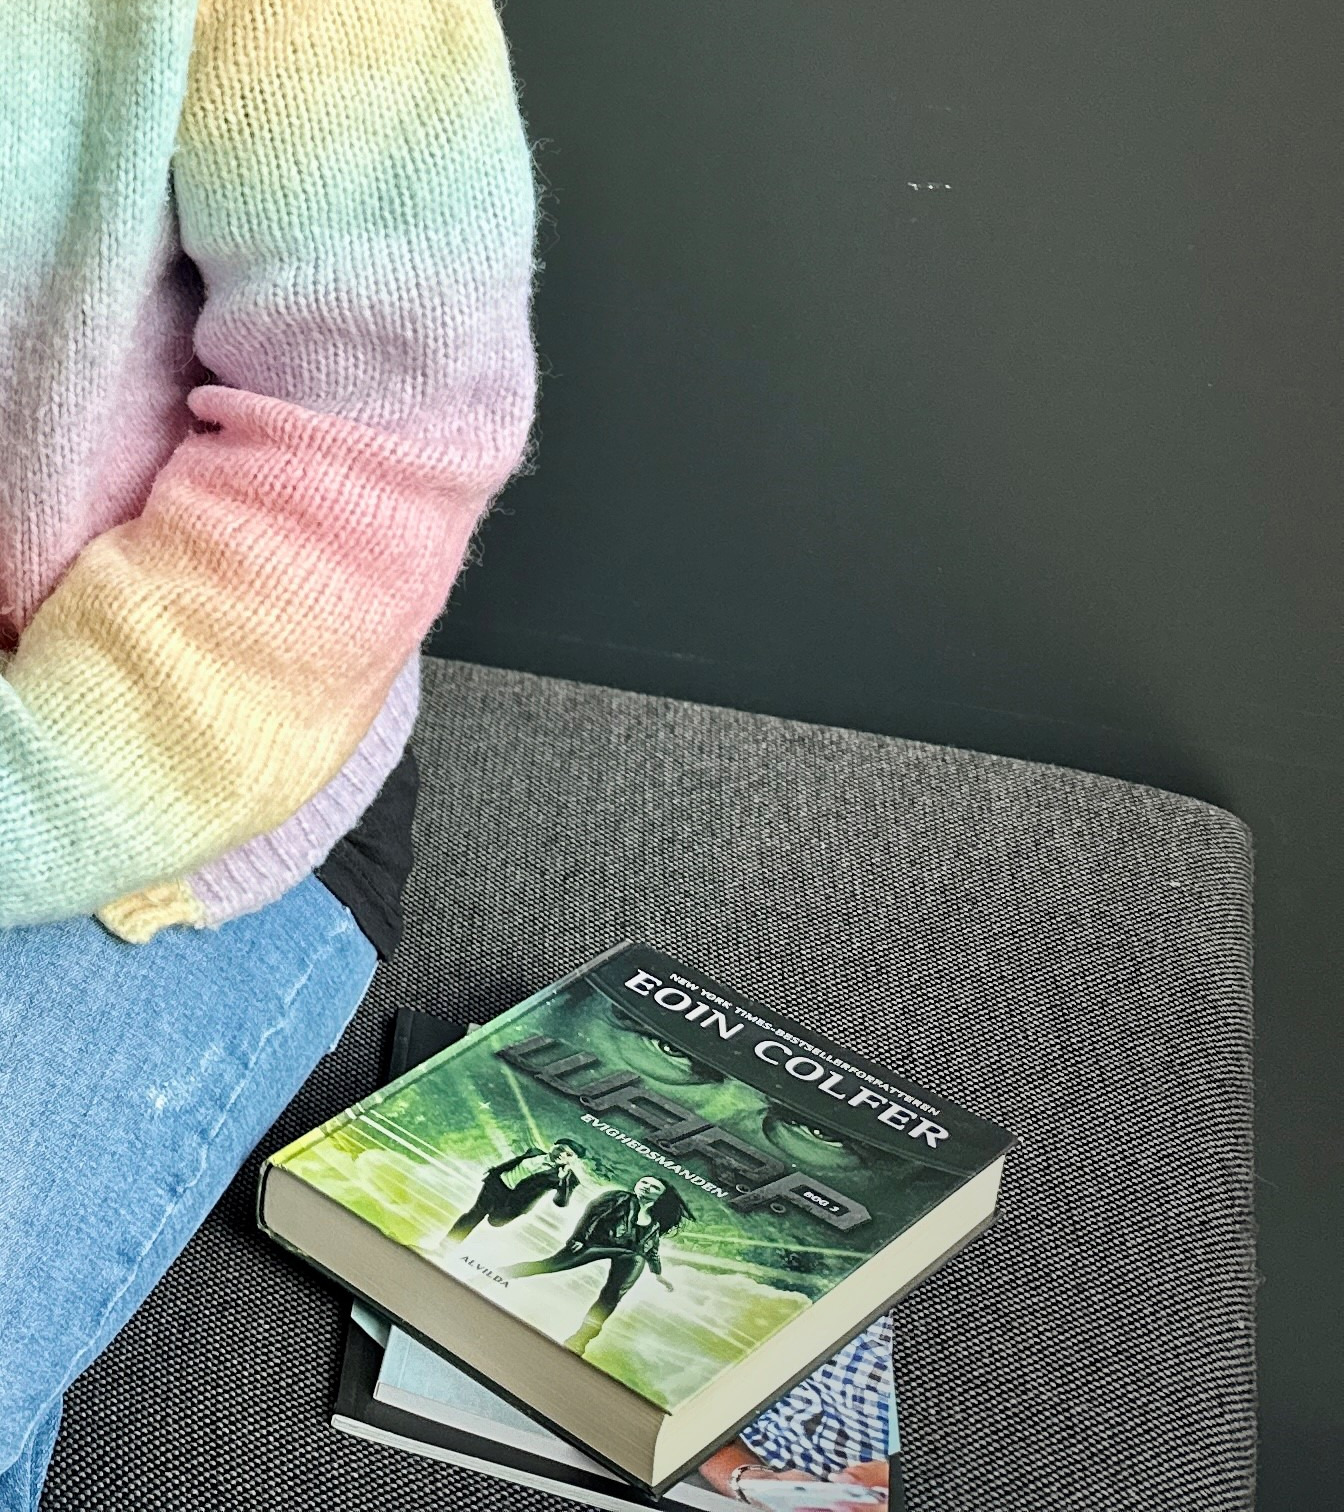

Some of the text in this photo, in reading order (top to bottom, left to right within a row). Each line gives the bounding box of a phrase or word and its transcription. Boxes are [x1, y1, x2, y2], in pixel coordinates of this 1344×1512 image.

[669, 972, 699, 992] NEW
[700, 988, 733, 1010] YORK
[624, 968, 951, 1149] EOIN COLFER
[580, 1113, 730, 1199] EVIGHEDSMANDEN
[458, 1254, 511, 1290] ALVILDA
